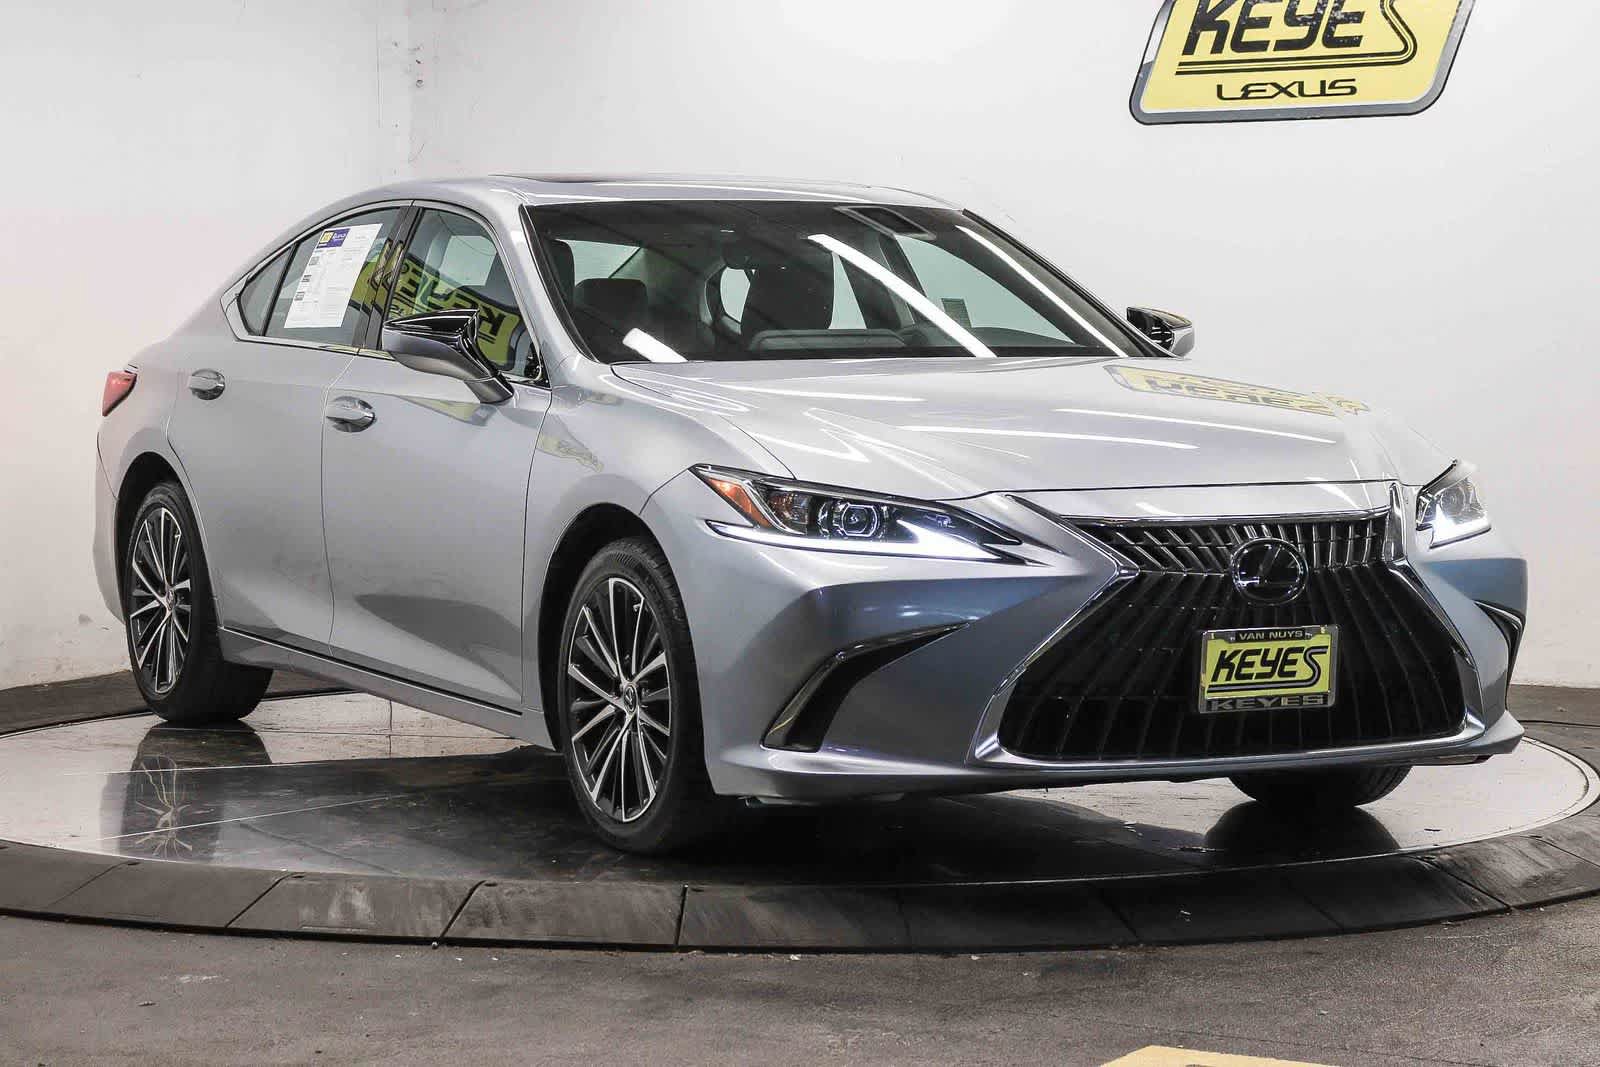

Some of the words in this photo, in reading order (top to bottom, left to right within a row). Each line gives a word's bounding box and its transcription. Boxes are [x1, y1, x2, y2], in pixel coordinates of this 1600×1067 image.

[1177, 0, 1417, 75] KEYES
[1216, 78, 1358, 101] LEXUS
[1239, 632, 1265, 641] VAN
[1269, 630, 1303, 639] NUYS
[1207, 646, 1329, 693] KEYES
[1210, 695, 1324, 711] KEYES
